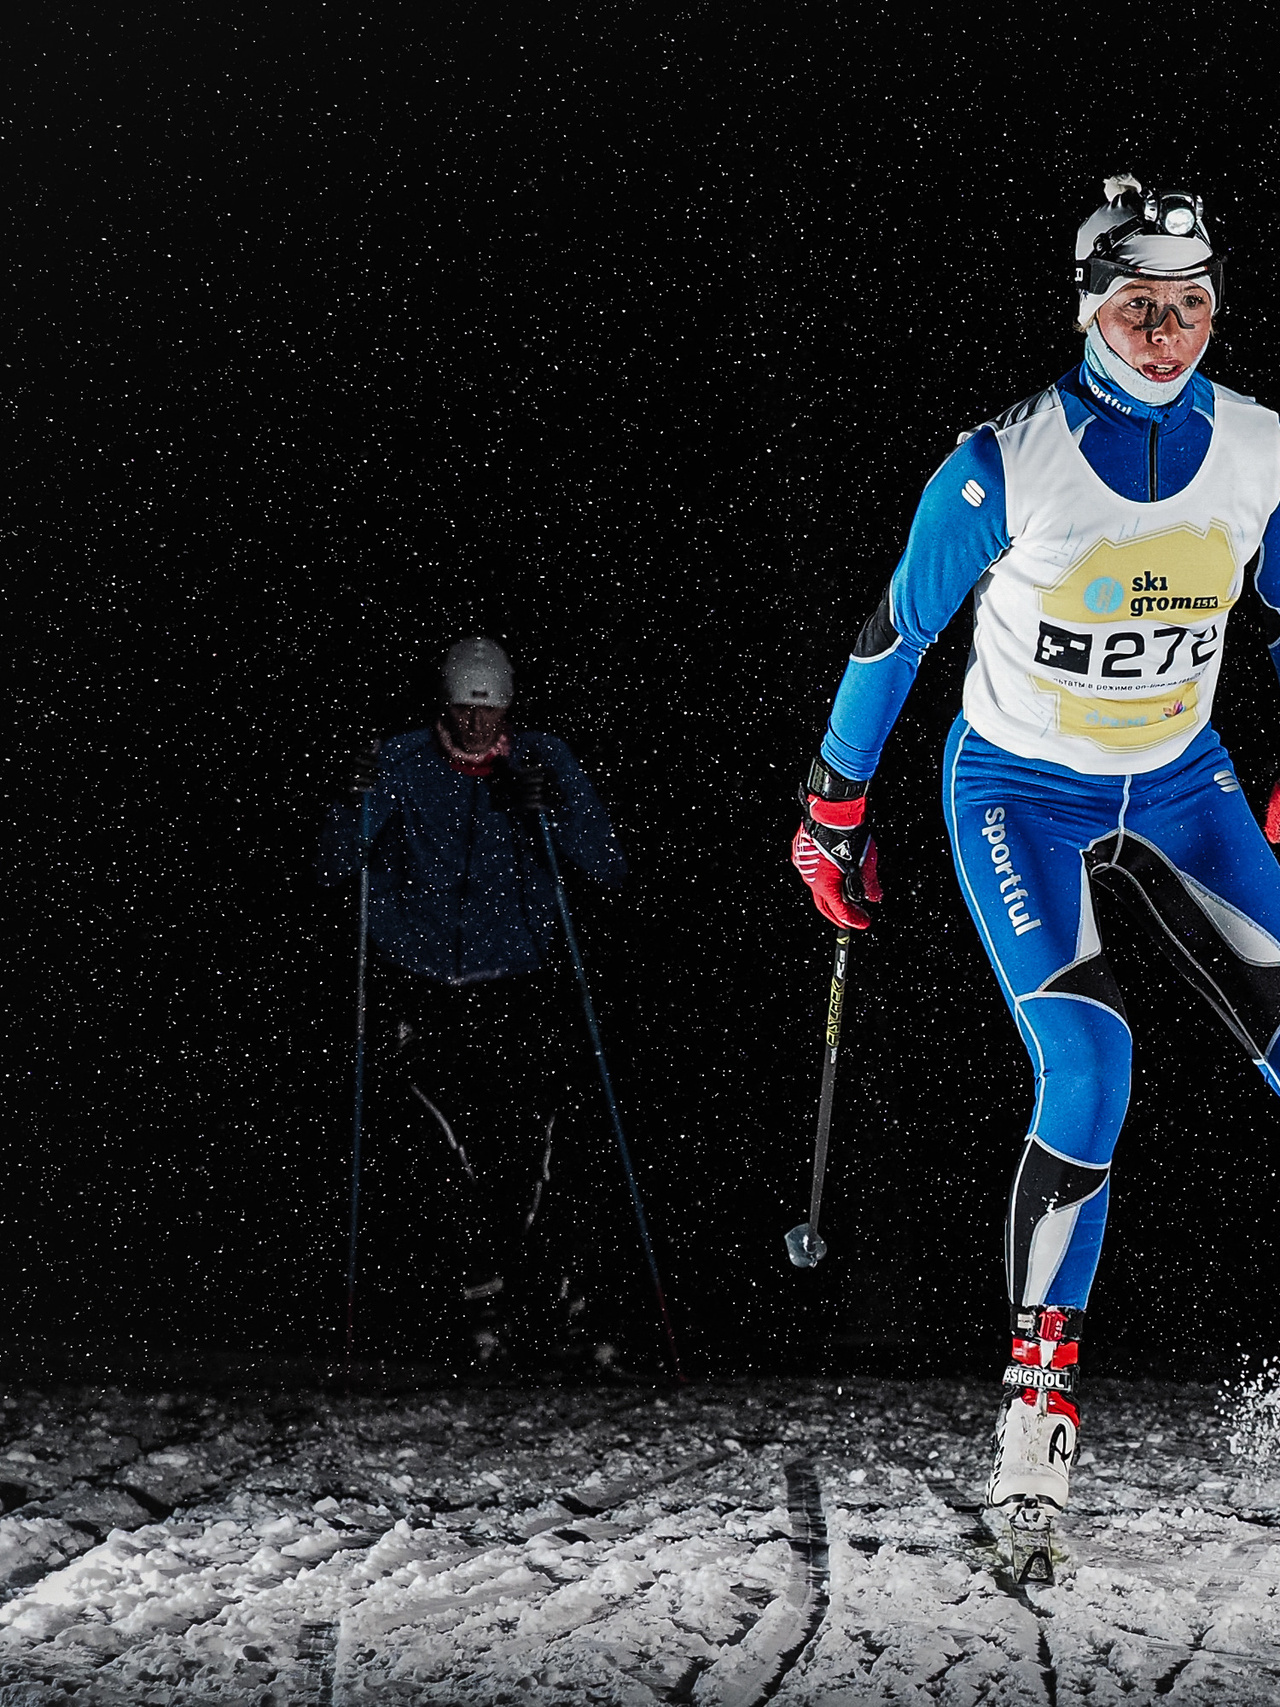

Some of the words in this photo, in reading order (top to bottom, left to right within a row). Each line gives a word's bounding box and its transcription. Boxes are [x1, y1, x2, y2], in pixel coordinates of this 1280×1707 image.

[1131, 570, 1168, 592] ski
[1130, 596, 1192, 617] grom
[1101, 624, 1217, 678] 272
[981, 806, 1042, 937] sportful
[1004, 1367, 1065, 1388] SSIGNOL
